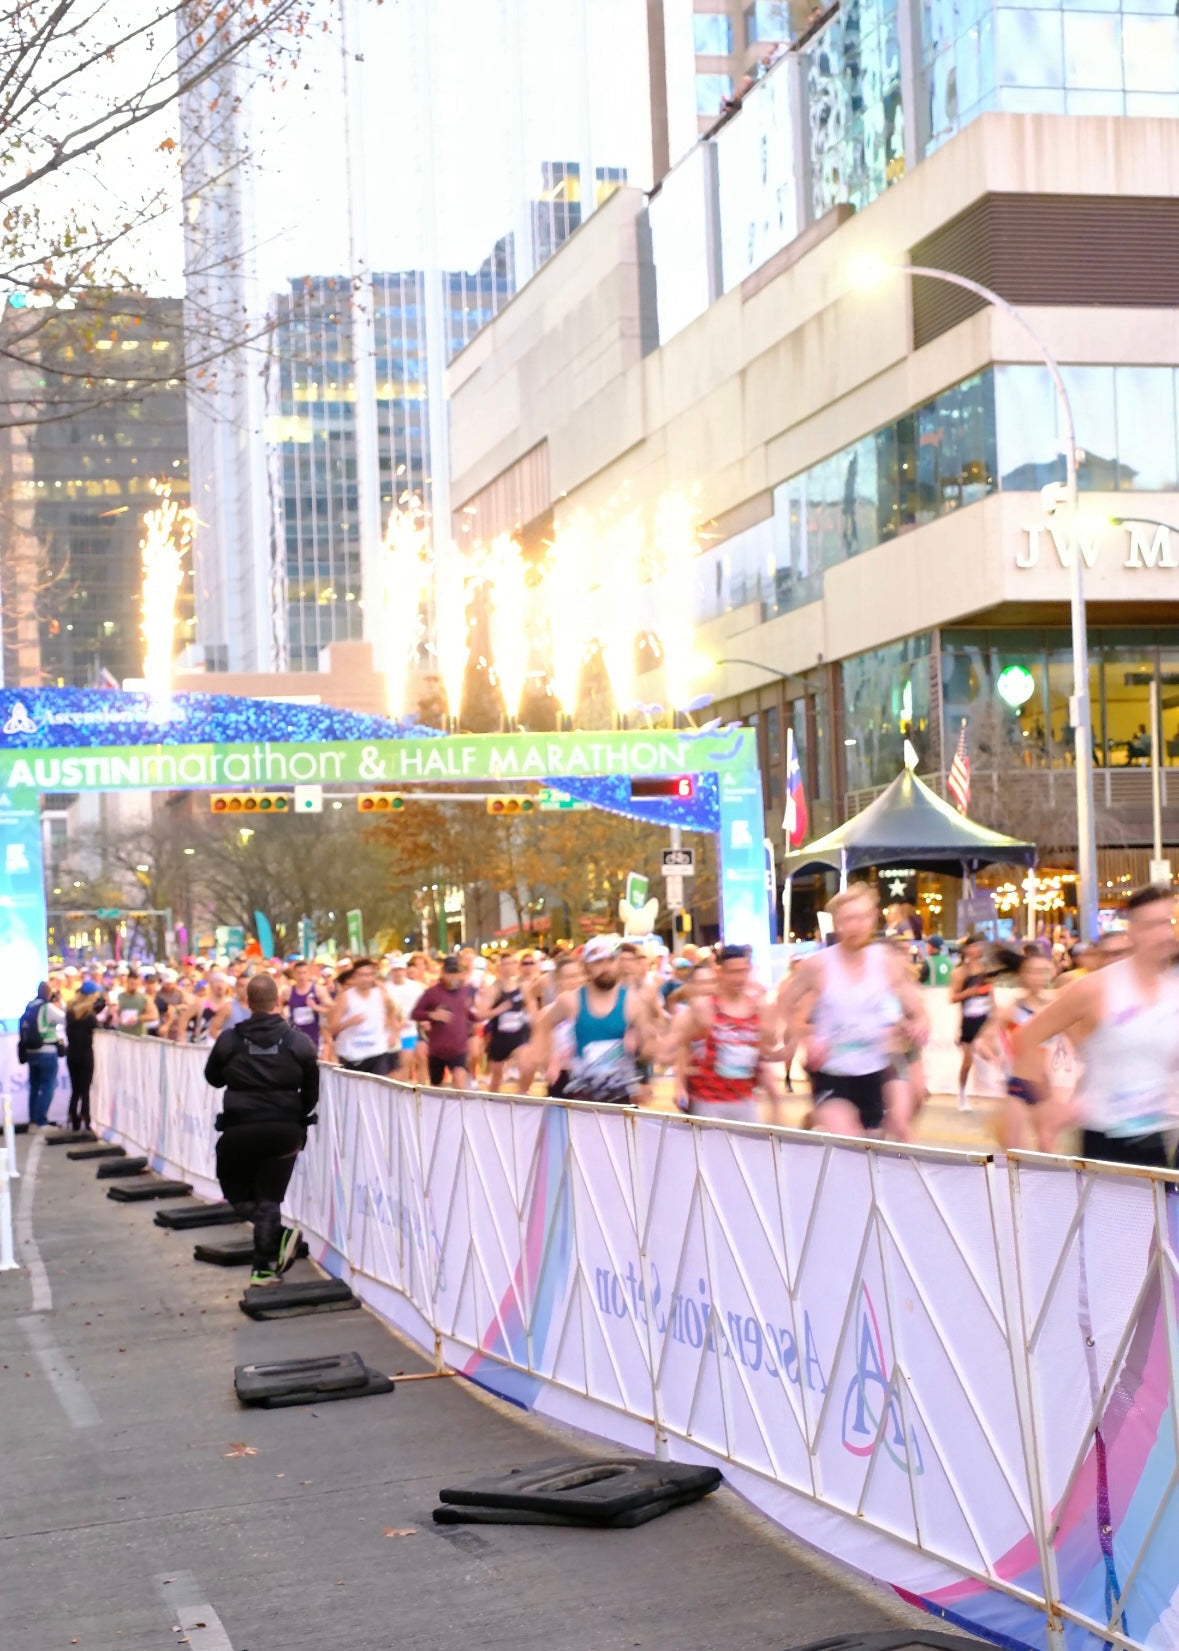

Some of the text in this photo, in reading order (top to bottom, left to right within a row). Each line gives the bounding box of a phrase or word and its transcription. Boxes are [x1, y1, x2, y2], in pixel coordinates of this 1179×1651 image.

[1016, 524, 1104, 569] JW
[358, 746, 387, 780] &
[401, 747, 477, 776] HALF
[488, 742, 687, 775] MARATHON
[679, 779, 690, 796] 6
